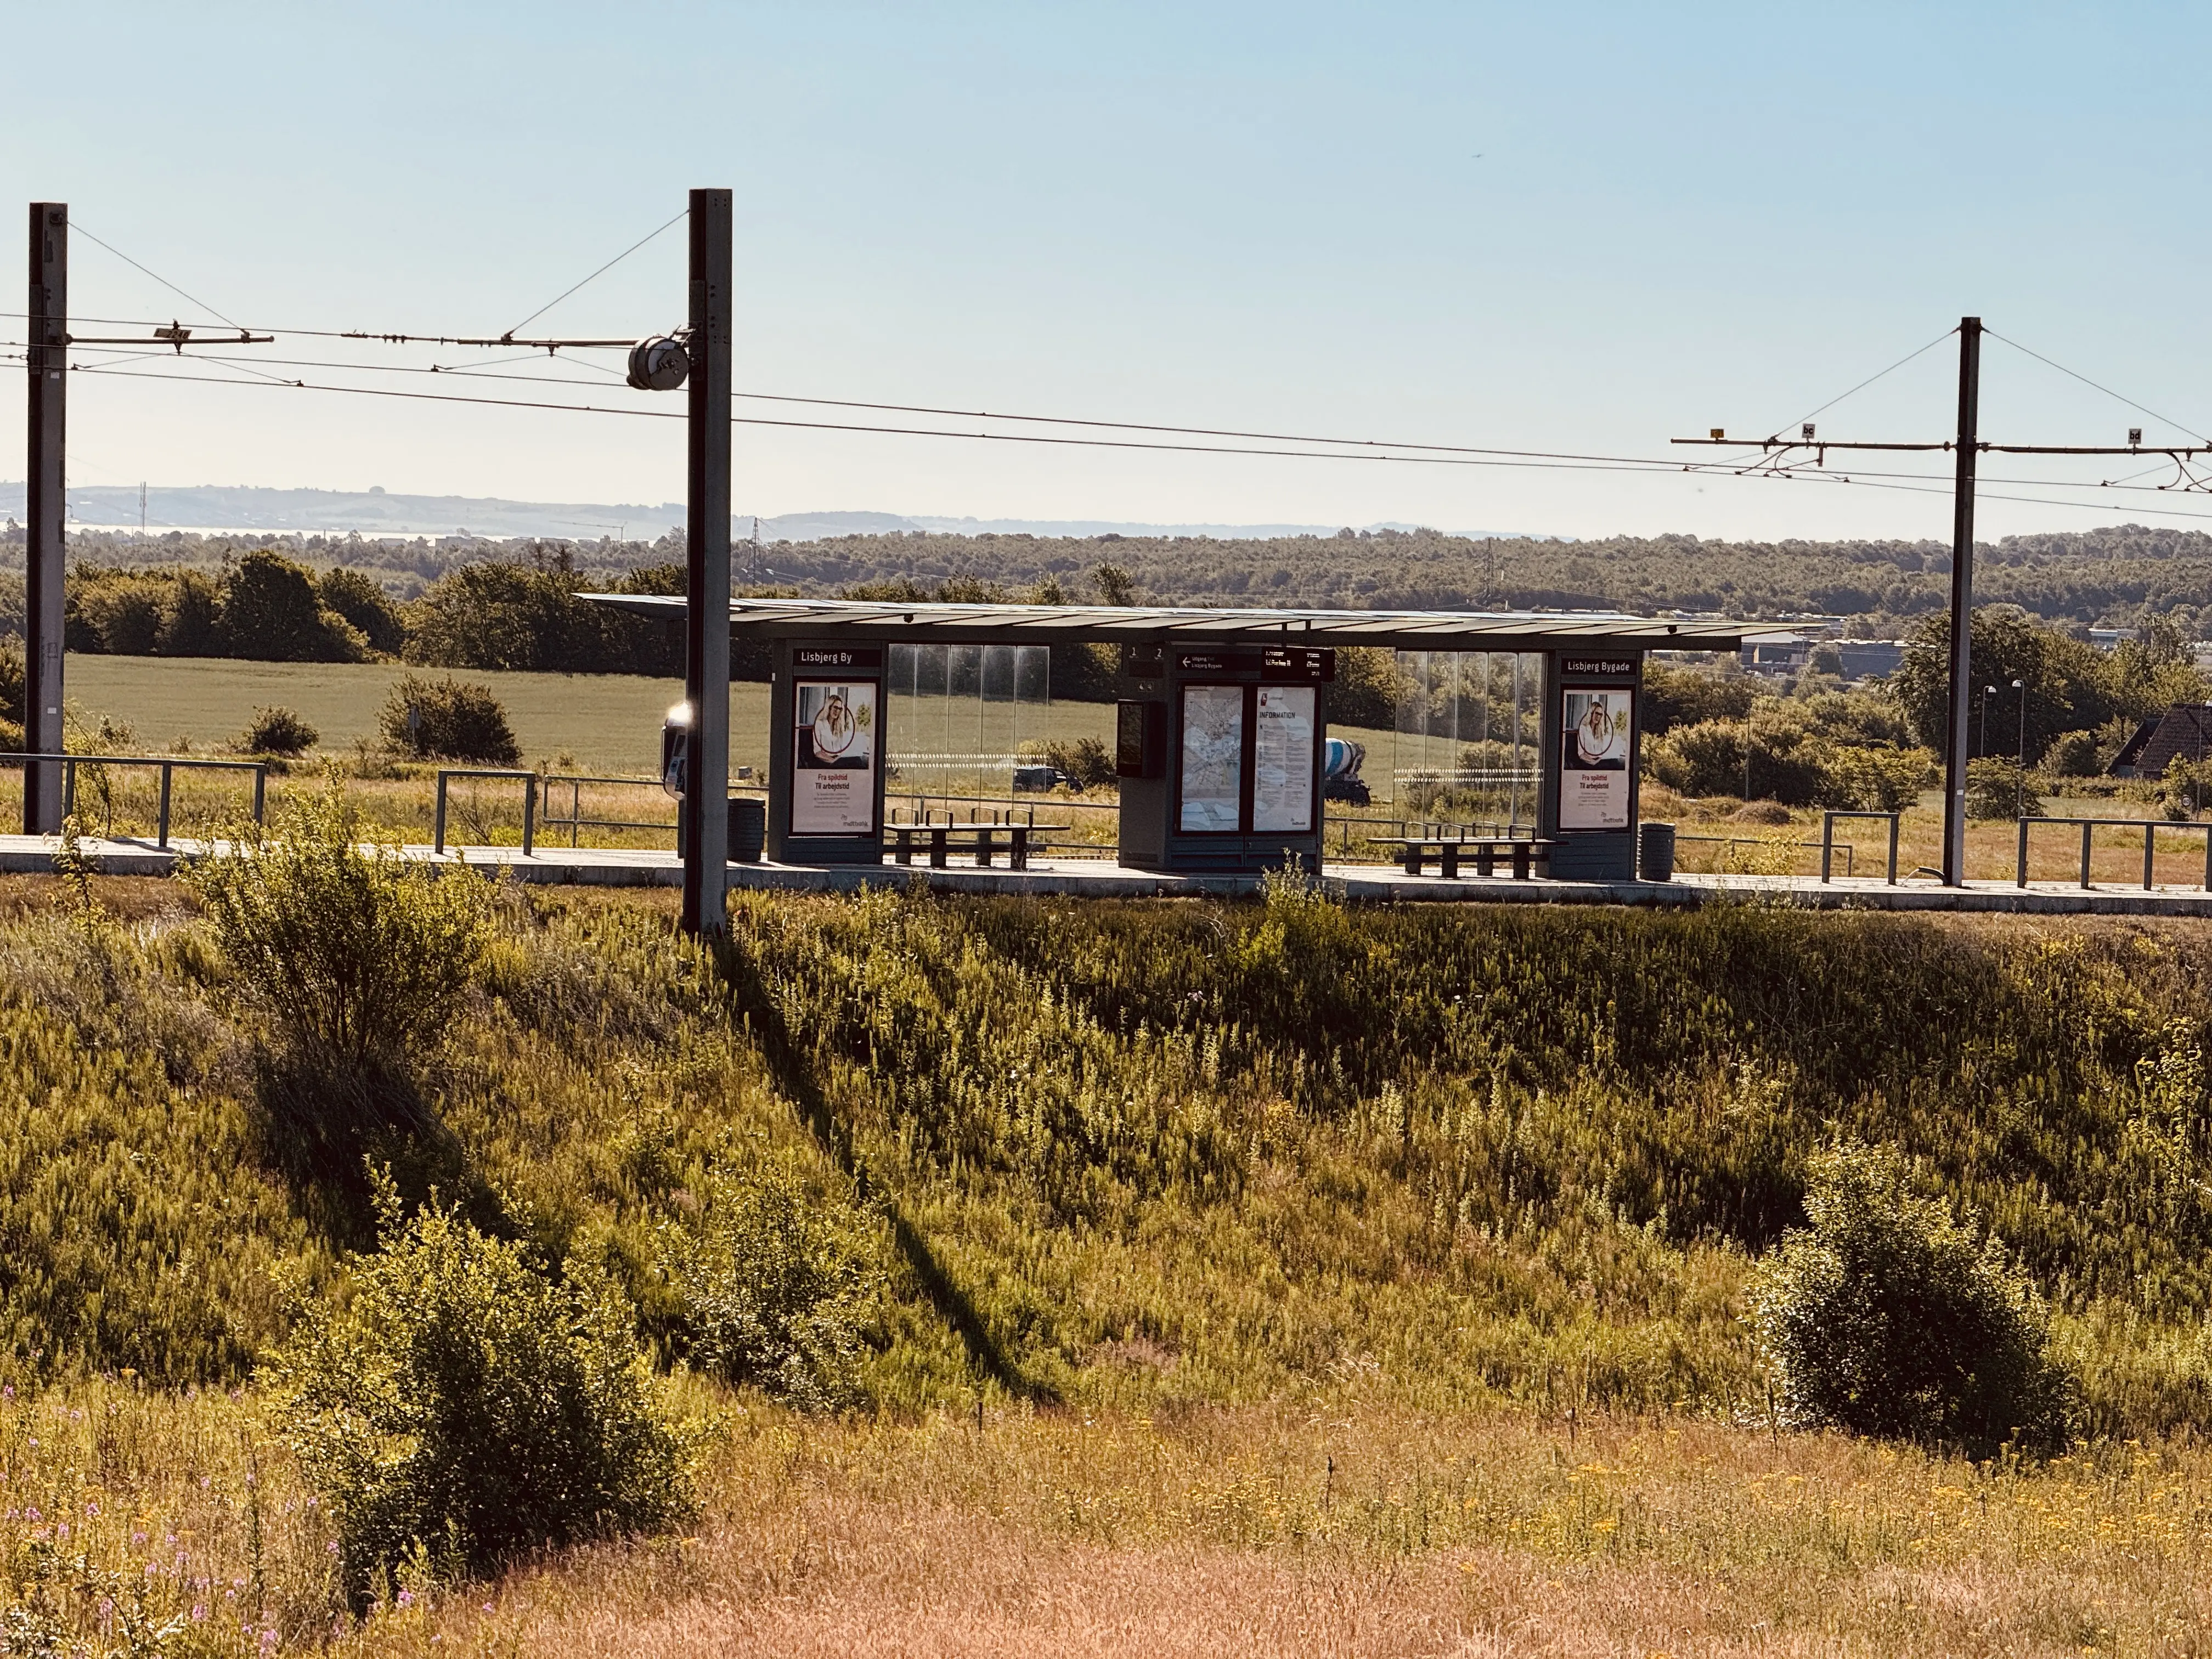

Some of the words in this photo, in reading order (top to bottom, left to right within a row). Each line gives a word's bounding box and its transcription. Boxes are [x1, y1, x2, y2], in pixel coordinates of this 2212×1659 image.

[1804, 426, 1814, 435] bc
[2130, 431, 2140, 439] bd
[1132, 647, 1137, 656] 1
[1157, 648, 1161, 657] 2
[801, 651, 838, 664] Lisbjerg
[840, 652, 852, 664] By
[1567, 661, 1599, 673] Lisbjerg
[1601, 662, 1630, 673] Bygade
[828, 774, 848, 782] spildtid
[822, 782, 850, 791] arbejdstid
